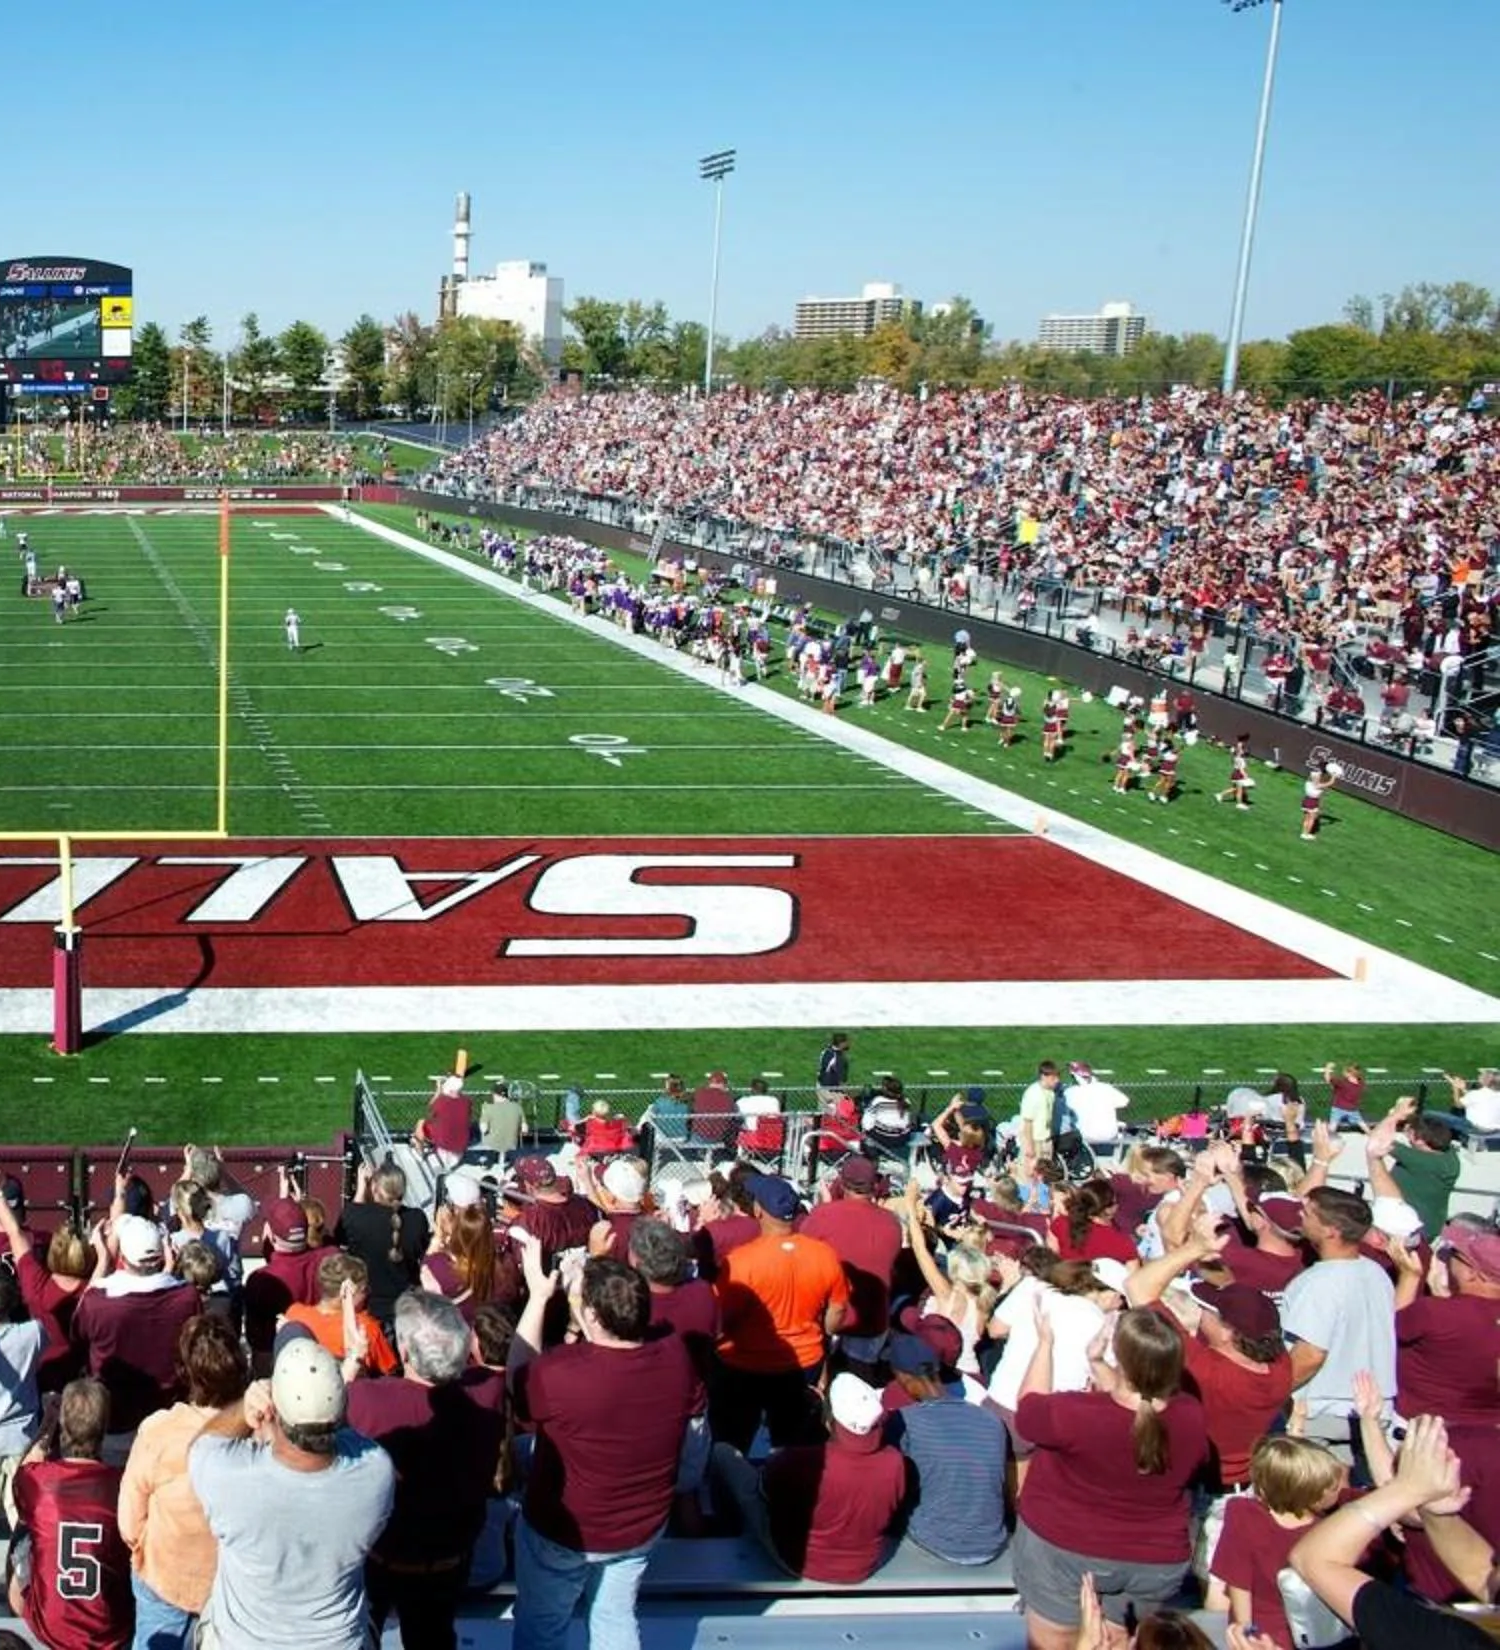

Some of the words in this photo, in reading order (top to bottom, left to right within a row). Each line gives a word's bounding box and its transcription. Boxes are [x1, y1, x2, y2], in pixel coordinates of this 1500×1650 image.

[1, 490, 42, 498] NATIONAL
[568, 733, 647, 757] 10
[56, 1521, 103, 1600] 5
